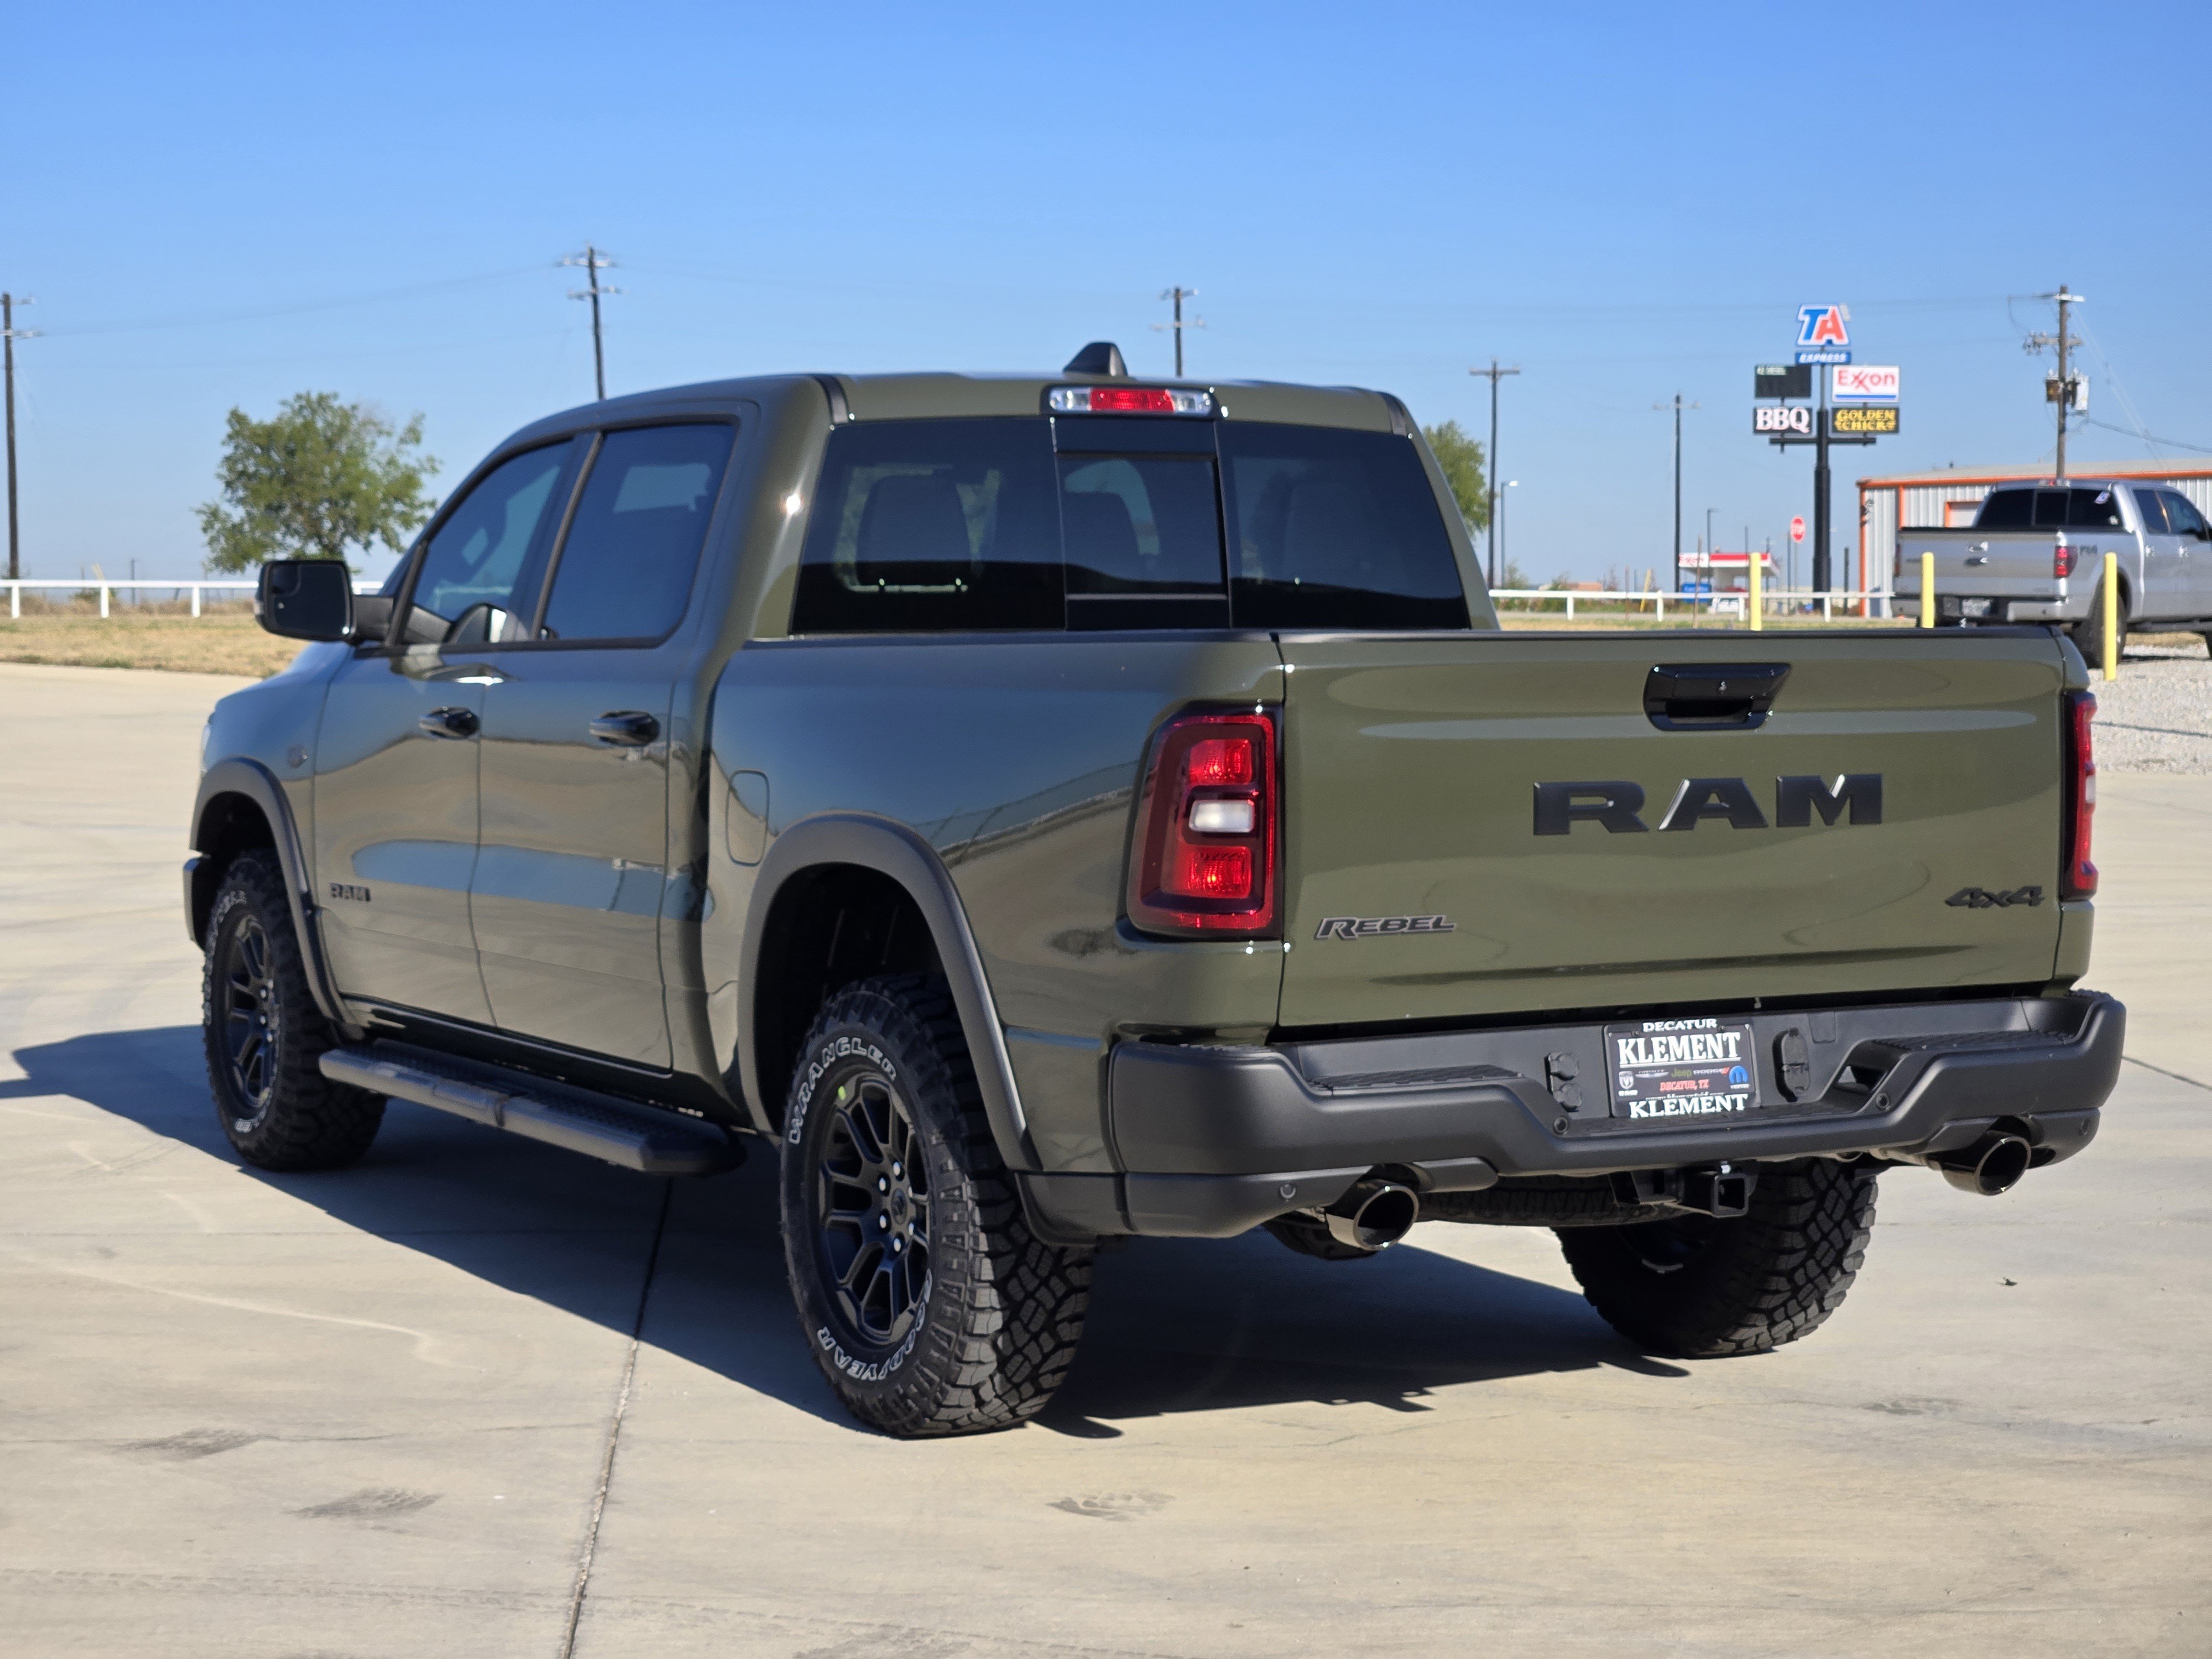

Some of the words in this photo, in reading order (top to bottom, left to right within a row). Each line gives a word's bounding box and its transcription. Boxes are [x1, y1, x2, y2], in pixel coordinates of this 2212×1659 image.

[1799, 306, 1848, 343] TA
[1799, 353, 1846, 363] EXPRESS
[1838, 370, 1895, 393] Exxon
[1756, 407, 1809, 433] BBQ
[1836, 409, 1896, 421] GOLDEN
[1841, 420, 1886, 431] CHICK
[1533, 774, 1882, 836] RAM
[330, 883, 371, 902] RAM
[1945, 885, 2045, 908] 4x4
[1314, 914, 1457, 941] REBEL
[1642, 1018, 1718, 1032] DECATUR
[1618, 1032, 1741, 1065] KLEMENT
[789, 1037, 896, 1145] WRANGLER
[1660, 1080, 1697, 1091] DECATUR,
[1698, 1079, 1709, 1089] TX
[1629, 1093, 1748, 1118] KLEMENT
[817, 1269, 933, 1381] GOODYEAR
